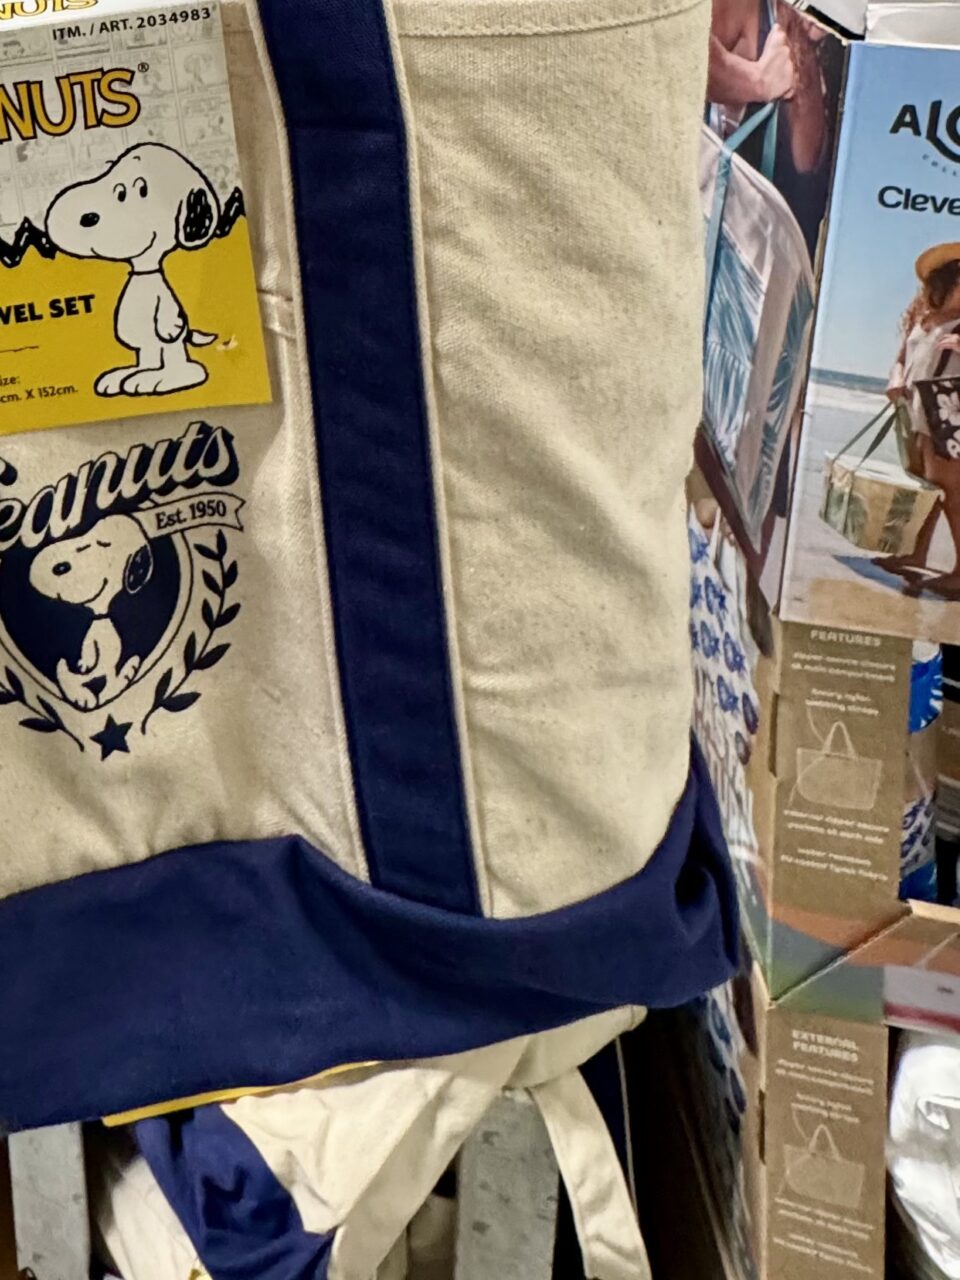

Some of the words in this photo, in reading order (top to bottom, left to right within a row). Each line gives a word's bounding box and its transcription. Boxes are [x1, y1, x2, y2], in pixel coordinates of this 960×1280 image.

[52, 25, 87, 41] ITM.
[98, 17, 134, 35] ART.
[136, 6, 211, 30] 2034983
[49, 294, 96, 319] SET
[25, 389, 35, 400] X
[38, 384, 79, 399] 152cm.
[154, 509, 186, 530] Est.
[189, 499, 228, 519] 1950
[810, 629, 881, 647] FEATURES
